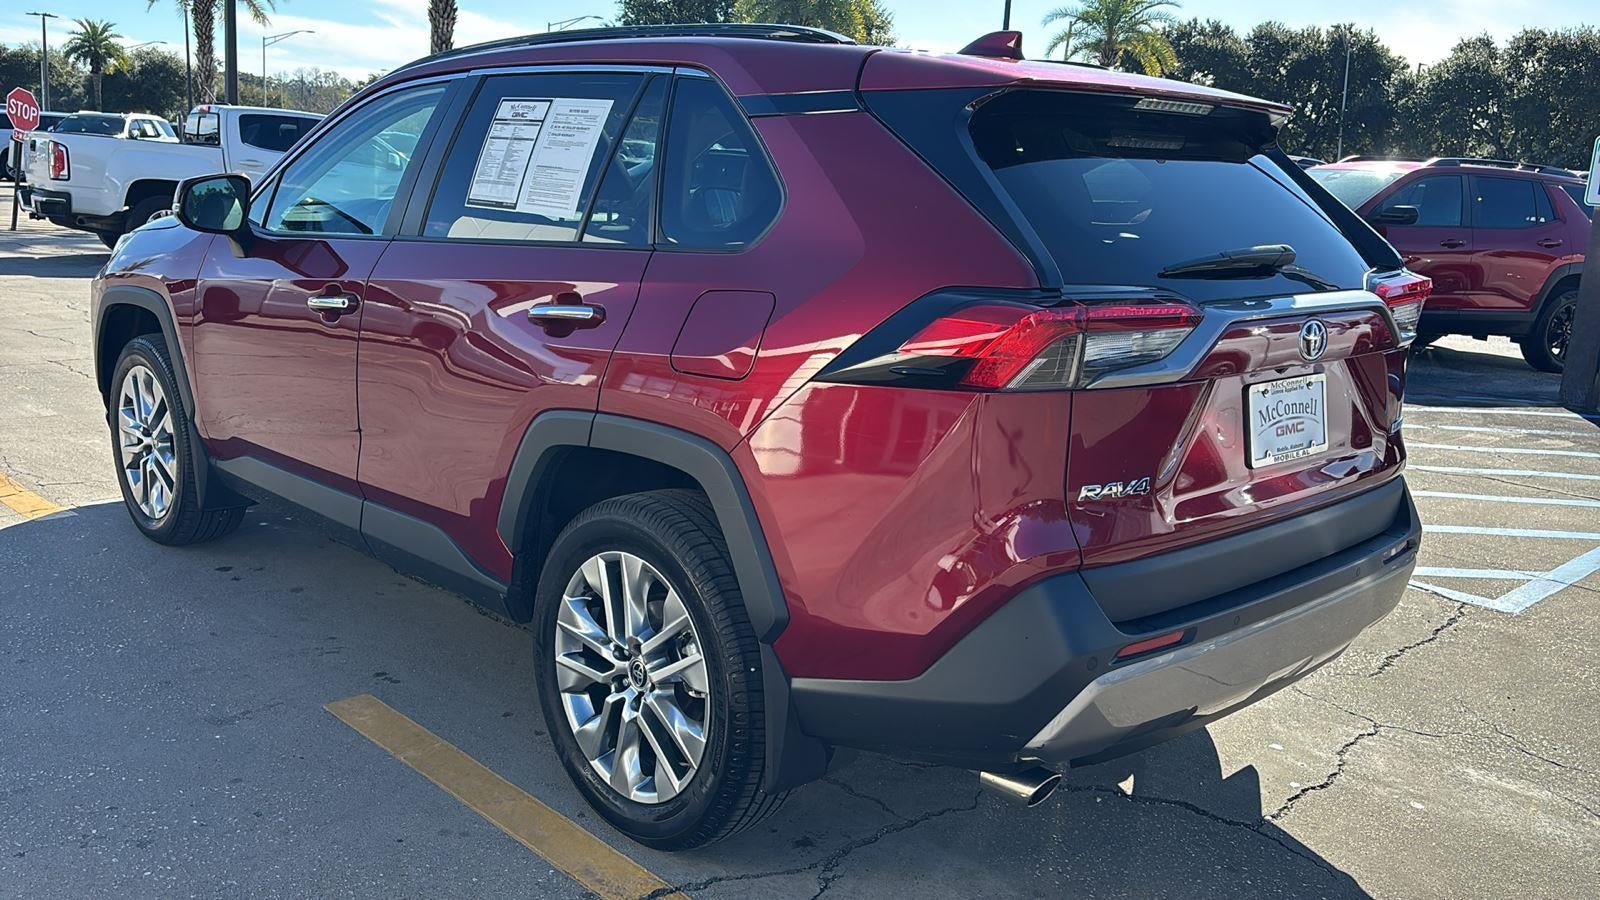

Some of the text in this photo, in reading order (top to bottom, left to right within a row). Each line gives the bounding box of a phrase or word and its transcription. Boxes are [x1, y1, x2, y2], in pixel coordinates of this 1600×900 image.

[9, 99, 37, 121] STOP
[1271, 377, 1308, 388] McConnell
[1258, 398, 1317, 426] McConnell
[1276, 421, 1305, 437] GMC
[1078, 477, 1150, 501] RAV4
